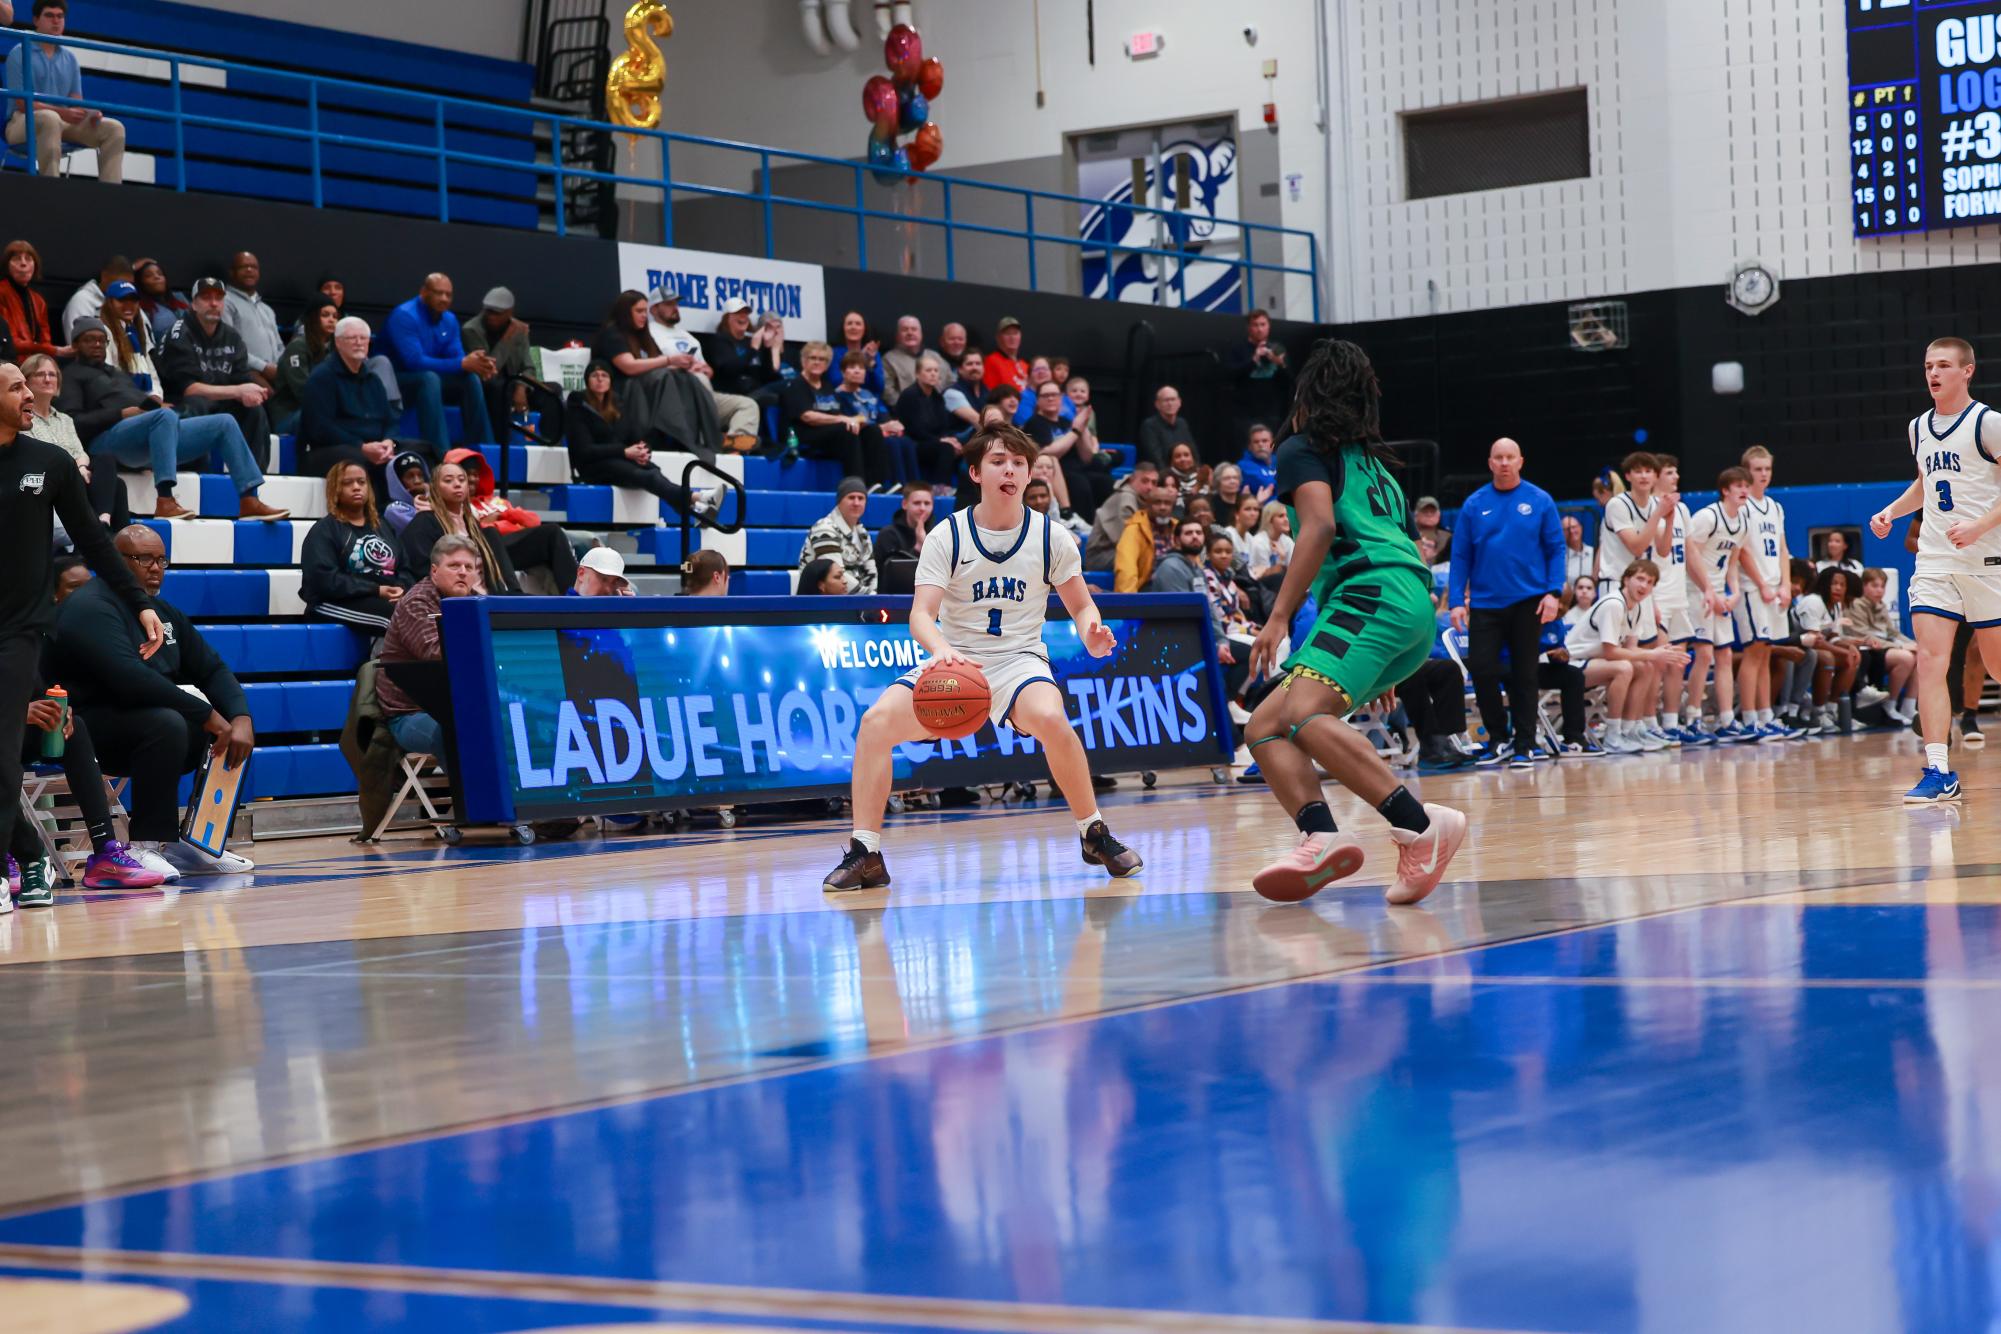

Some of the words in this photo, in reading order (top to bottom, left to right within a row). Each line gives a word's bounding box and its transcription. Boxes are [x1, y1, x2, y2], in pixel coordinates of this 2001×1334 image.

[1936, 13, 2001, 67] GU
[1874, 86, 1896, 104] PT
[1940, 67, 2001, 114] LOG
[1856, 115, 1867, 131] 5
[1880, 112, 1892, 129] 0
[1904, 109, 1916, 126] 0
[1852, 138, 1873, 156] 12
[1881, 136, 1894, 152] 0
[1905, 133, 1917, 150] 0
[1941, 112, 2001, 163] #3
[1857, 163, 1869, 179] 4
[1882, 160, 1895, 177] 2
[1906, 158, 1916, 174] 1
[1942, 162, 2001, 193] SOPH
[1854, 187, 1875, 204] 15
[1883, 184, 1896, 201] 0
[1908, 182, 1917, 199] 1
[1860, 211, 1869, 228] 1
[1884, 208, 1897, 226] 3
[1908, 206, 1920, 223] 0
[1925, 450, 1961, 476] RAMS
[1936, 480, 1954, 512] 3
[1763, 539, 1777, 557] 12
[1716, 554, 1728, 570] 4
[972, 576, 1027, 603] RAMS
[986, 607, 1003, 637] 1
[818, 638, 926, 669] WELCOME
[918, 684, 961, 694] LEGACY
[508, 694, 724, 788] LADUE
